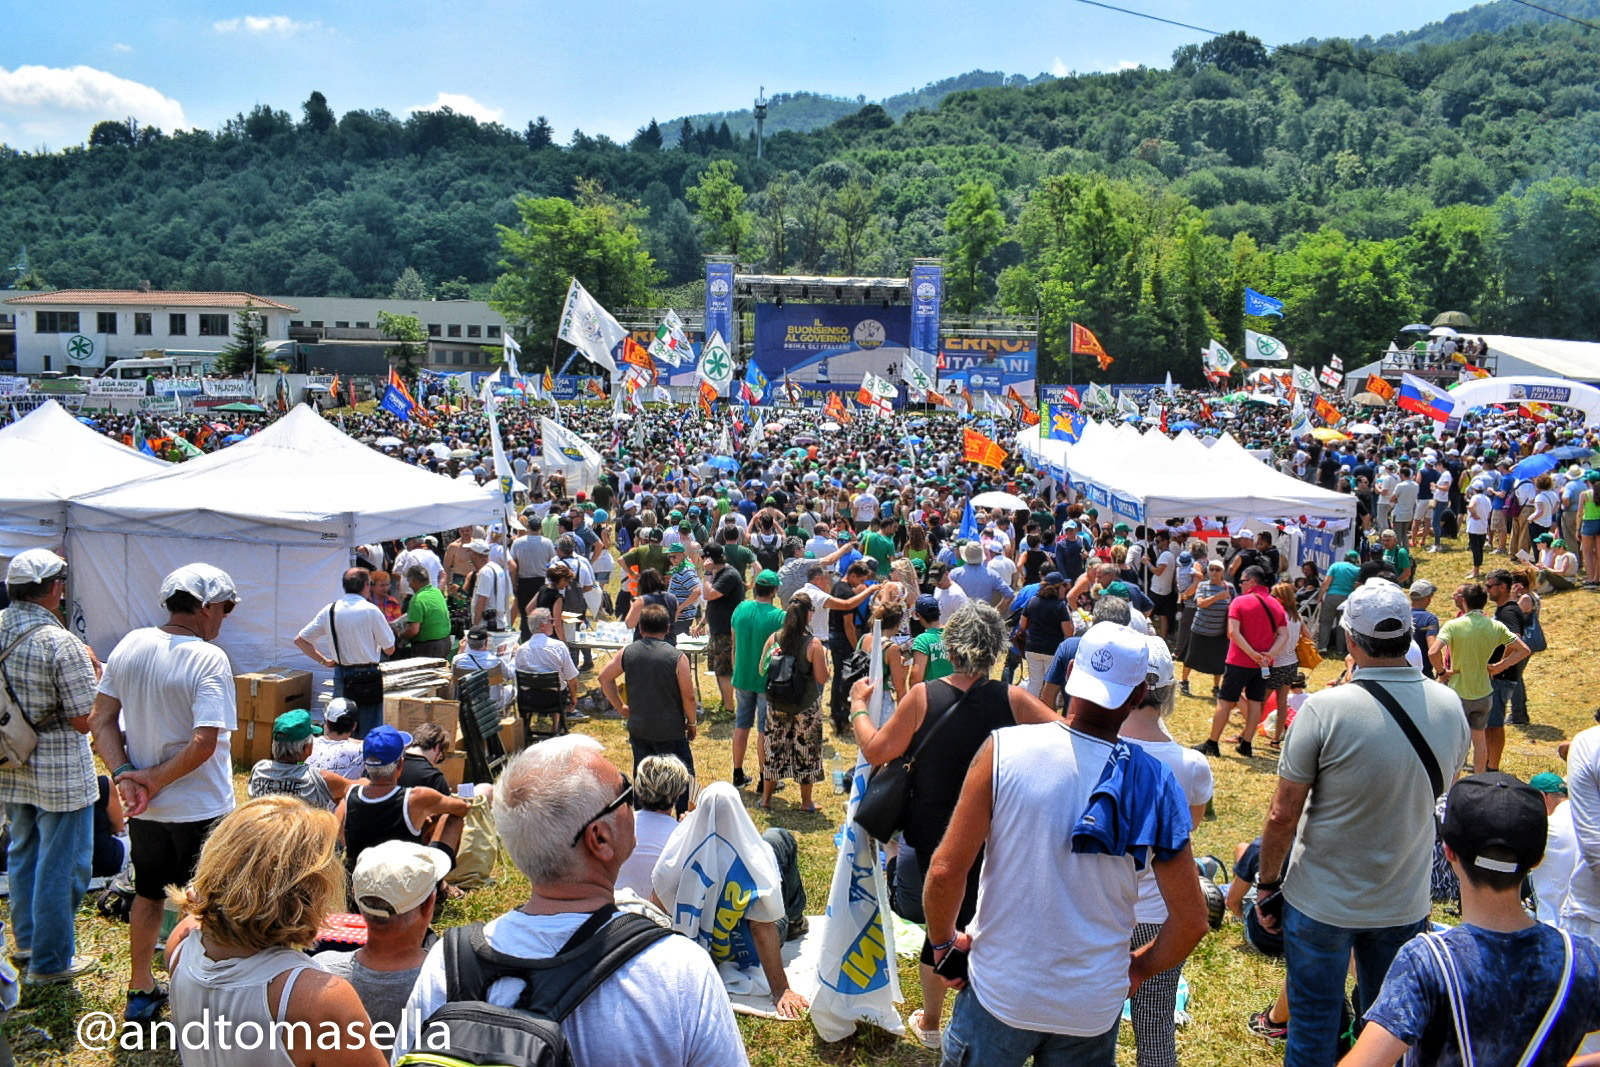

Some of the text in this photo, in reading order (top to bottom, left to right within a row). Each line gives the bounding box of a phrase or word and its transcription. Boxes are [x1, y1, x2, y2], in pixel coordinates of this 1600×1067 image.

[814, 318, 823, 326] IL
[787, 325, 849, 334] BUONSENSO
[784, 333, 851, 343] AL GOVERNO!
[1556, 388, 1568, 396] GLI
[278, 780, 302, 790] THE
